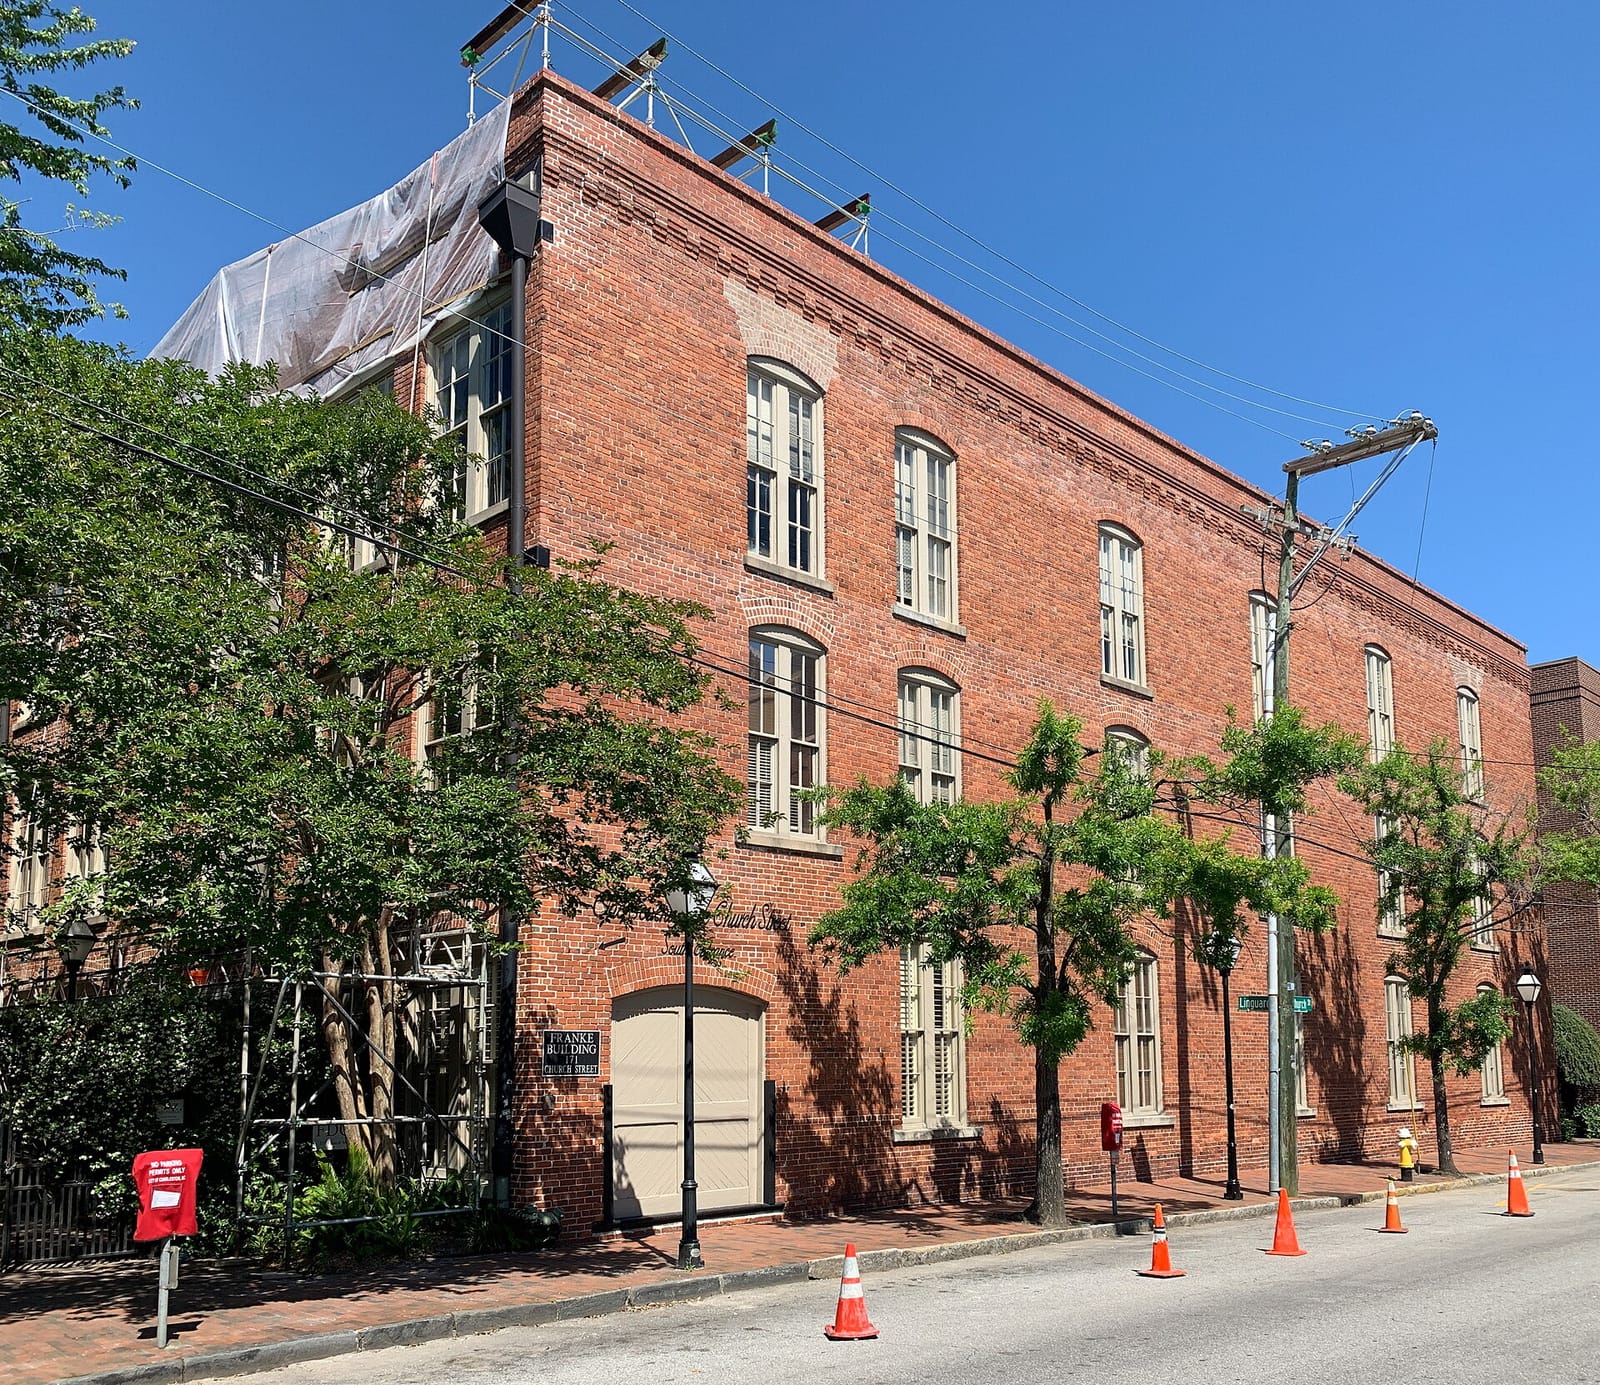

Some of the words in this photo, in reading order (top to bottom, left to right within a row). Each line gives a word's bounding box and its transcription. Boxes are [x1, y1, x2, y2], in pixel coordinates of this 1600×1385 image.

[713, 900, 757, 929] Church
[758, 903, 792, 931] Street
[550, 1033, 594, 1043] FRANKE
[547, 1044, 596, 1054] BUILDING
[565, 1055, 578, 1064] 171
[544, 1065, 571, 1073] CHURCH
[574, 1065, 598, 1074] STREET
